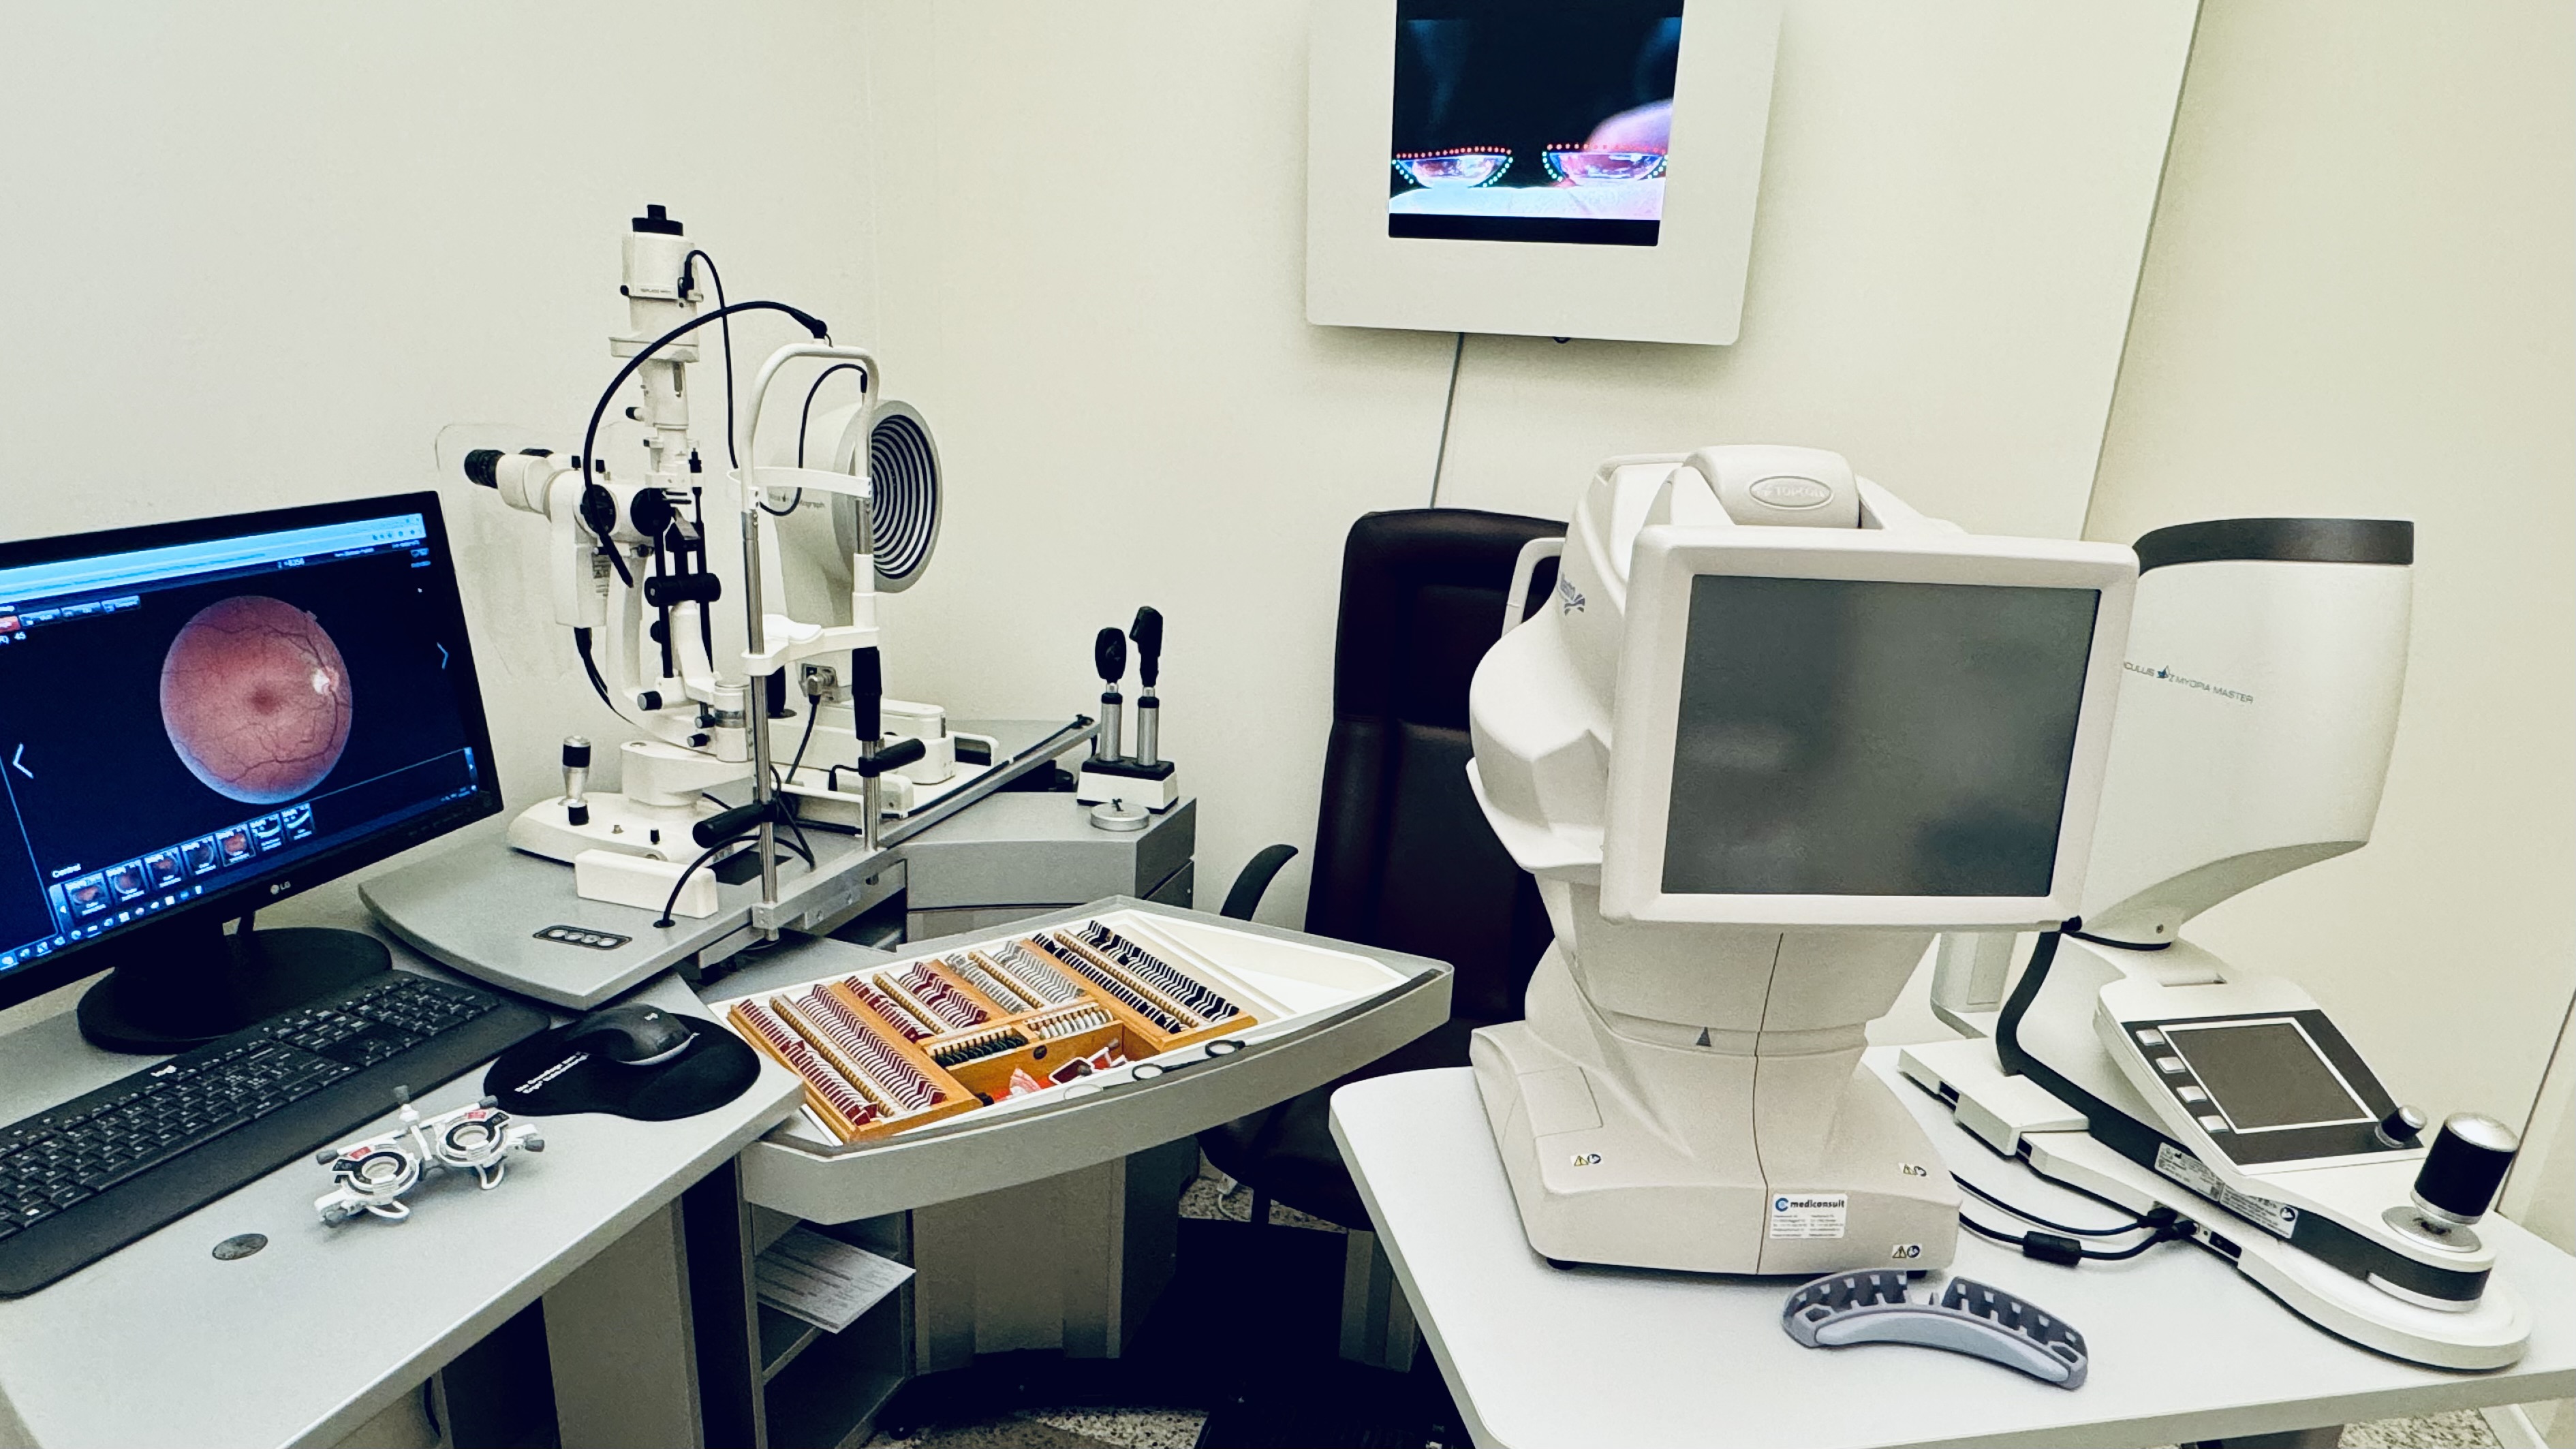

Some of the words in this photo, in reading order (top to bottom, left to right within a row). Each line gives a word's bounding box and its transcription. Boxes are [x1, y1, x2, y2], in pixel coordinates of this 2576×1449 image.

[2174, 675, 2210, 691] MYOPIA
[2213, 686, 2254, 704] MASTER
[1790, 1200, 1845, 1208] mediconsult
